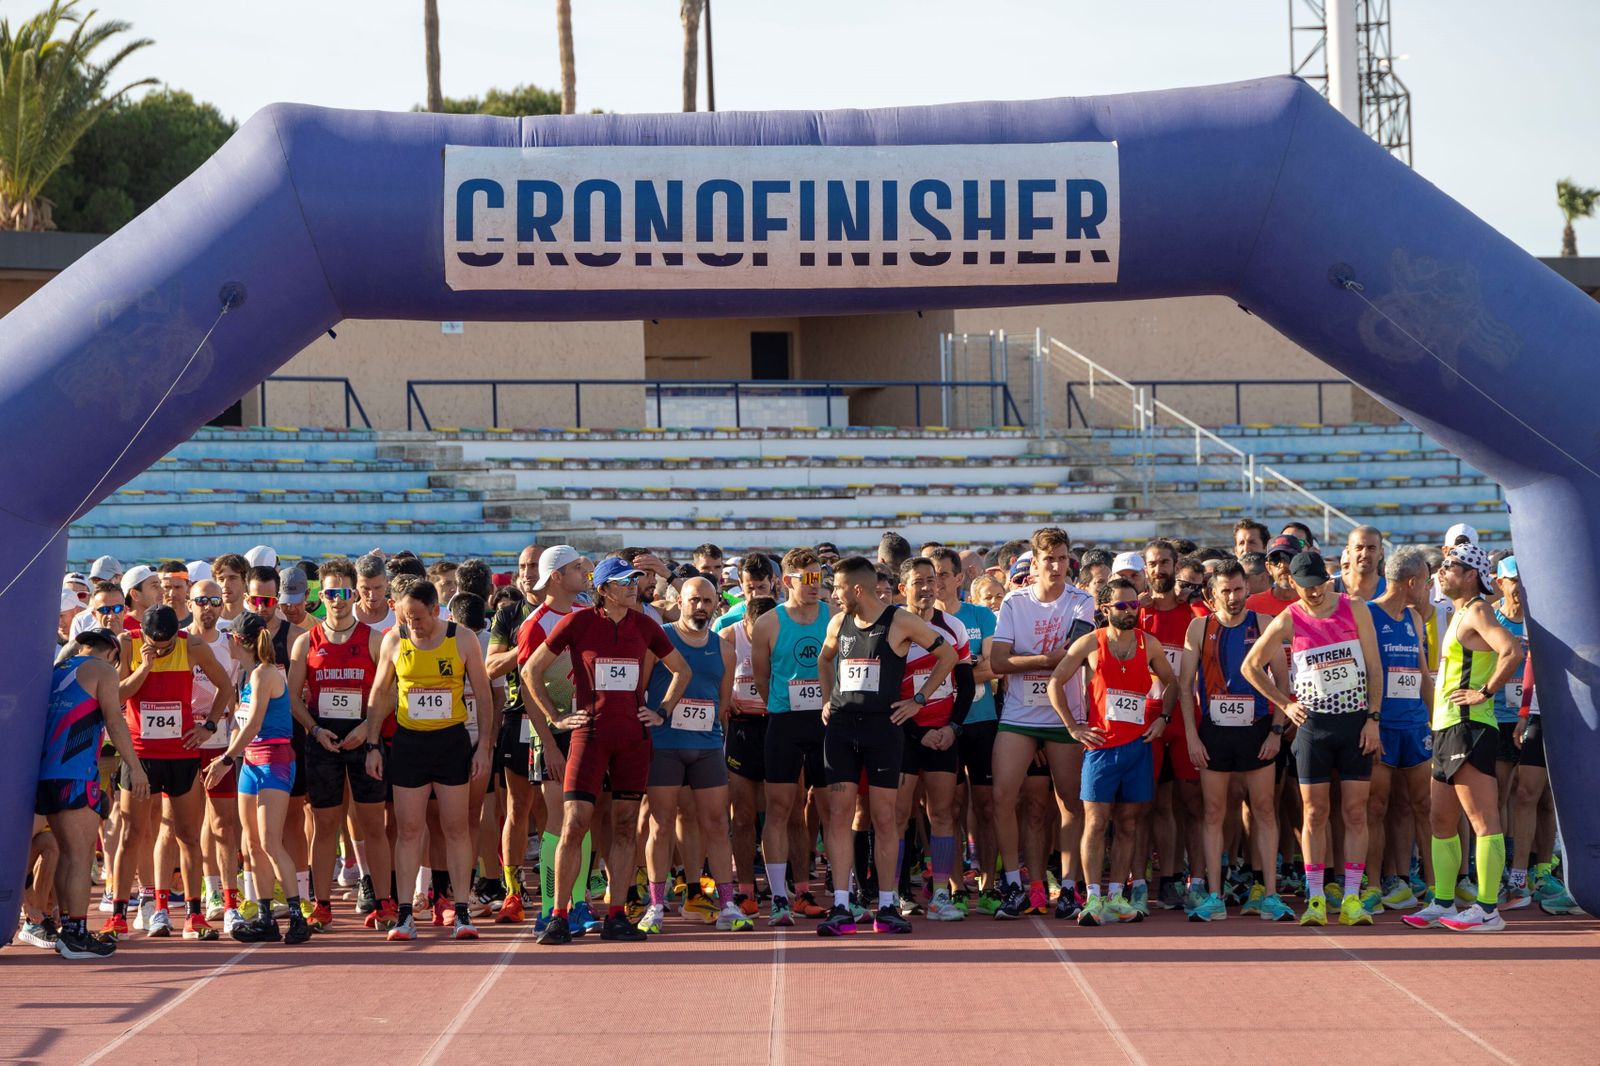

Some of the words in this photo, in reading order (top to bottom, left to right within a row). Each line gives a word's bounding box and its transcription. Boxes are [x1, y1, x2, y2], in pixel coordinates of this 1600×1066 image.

[455, 178, 1111, 267] CRONOFINISHER
[800, 646, 819, 659] AR
[1305, 647, 1353, 667] ENTRENA
[610, 666, 626, 678] 54
[848, 667, 870, 679] 511
[1323, 666, 1348, 682] 353
[1397, 675, 1416, 687] 480
[799, 686, 823, 698] 493
[1032, 682, 1048, 694] 23
[332, 695, 349, 707] 55
[418, 695, 443, 707] 416
[1115, 697, 1138, 711] 425
[683, 706, 707, 720] 575
[1219, 702, 1245, 714] 645
[146, 715, 176, 728] 784
